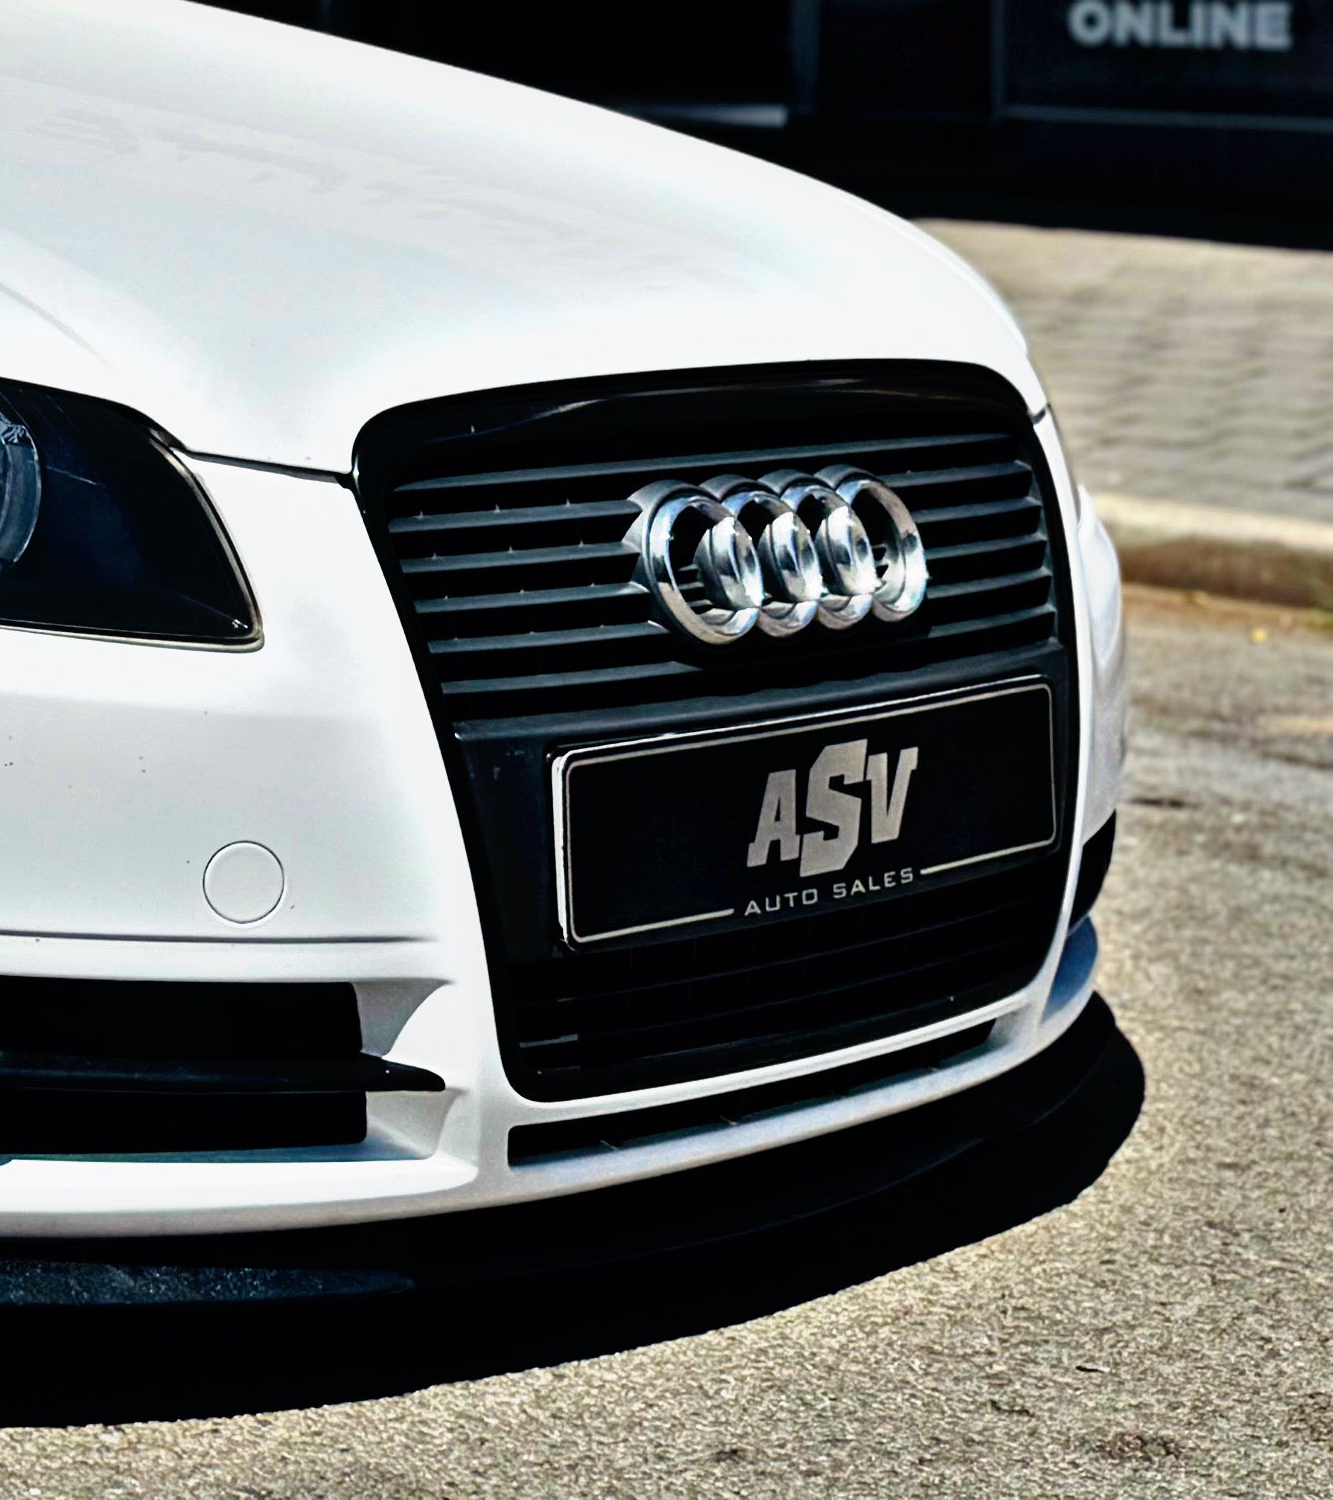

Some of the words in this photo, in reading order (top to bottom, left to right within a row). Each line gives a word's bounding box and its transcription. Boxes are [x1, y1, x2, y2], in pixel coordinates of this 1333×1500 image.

[746, 738, 920, 878] ASV
[744, 888, 819, 916] AUTO
[833, 867, 914, 899] SALES
